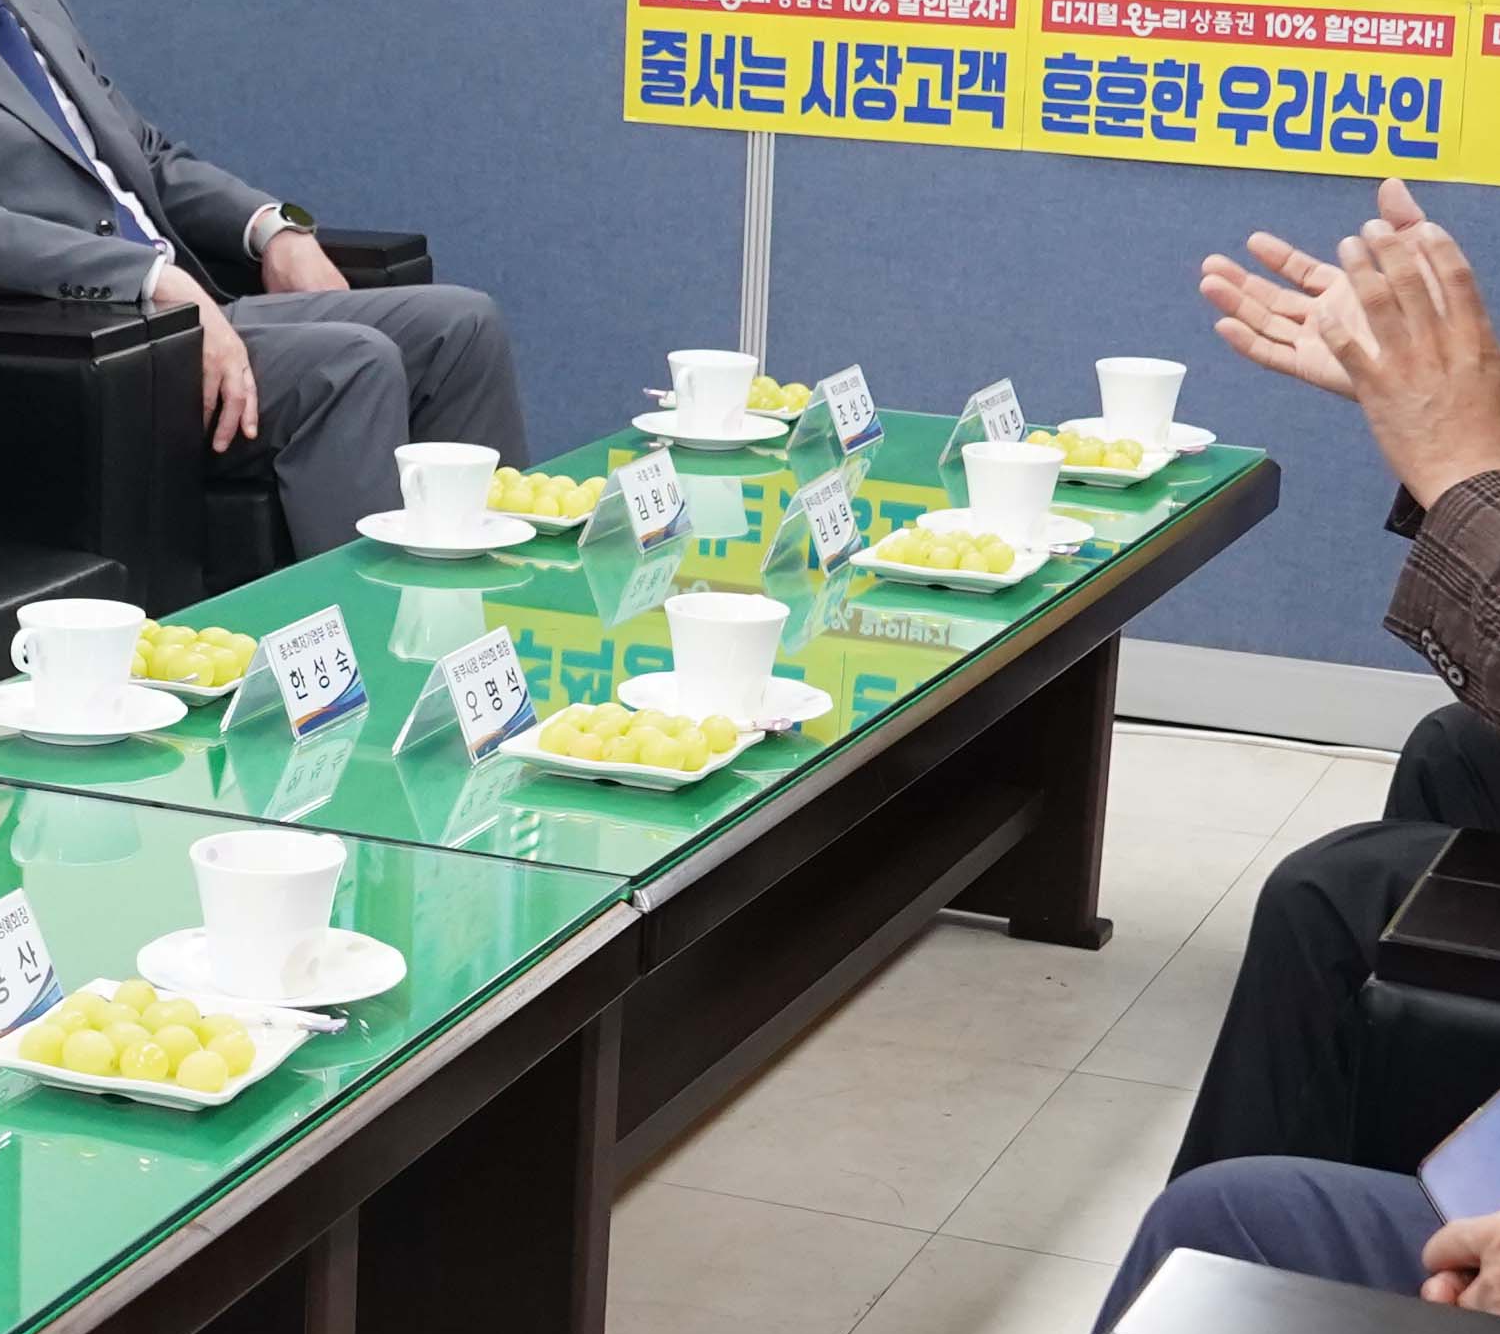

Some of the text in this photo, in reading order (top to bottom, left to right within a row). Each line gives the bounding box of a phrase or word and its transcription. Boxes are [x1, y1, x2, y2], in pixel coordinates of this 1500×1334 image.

[1050, 0, 1446, 50] 디지털 온누리 상품권 10% 할인받자!
[640, 28, 1008, 130] 줄서는 시장고객
[1040, 51, 1444, 160] 훈훈한 우리상인
